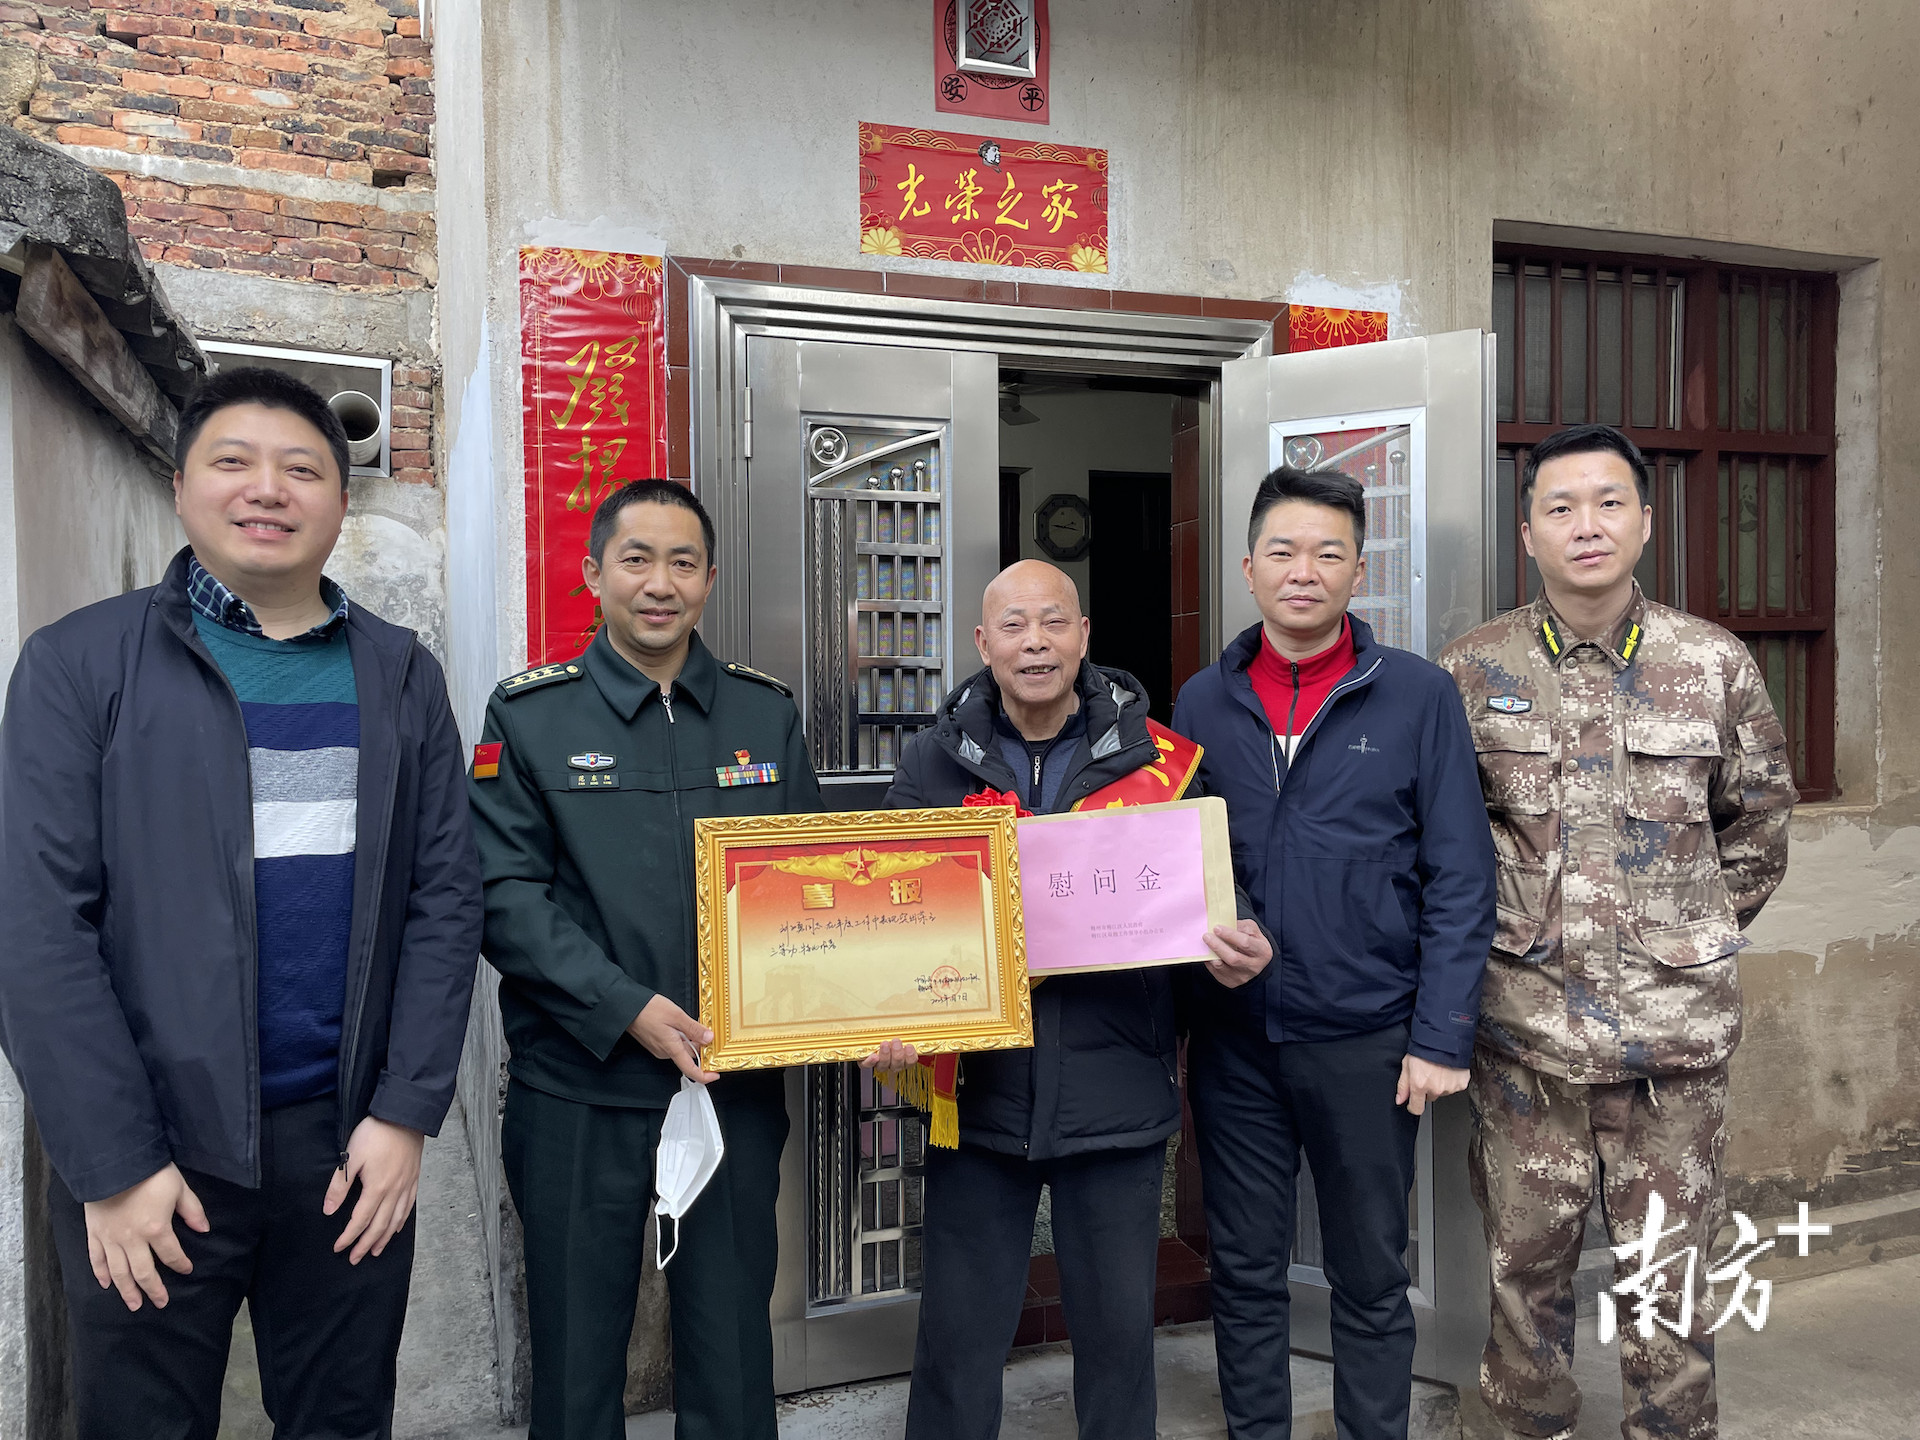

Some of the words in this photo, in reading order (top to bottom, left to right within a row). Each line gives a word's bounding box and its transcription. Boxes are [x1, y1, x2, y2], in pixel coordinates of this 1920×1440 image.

[802, 877, 922, 910] 喜报
[1048, 863, 1162, 898] 慰问金
